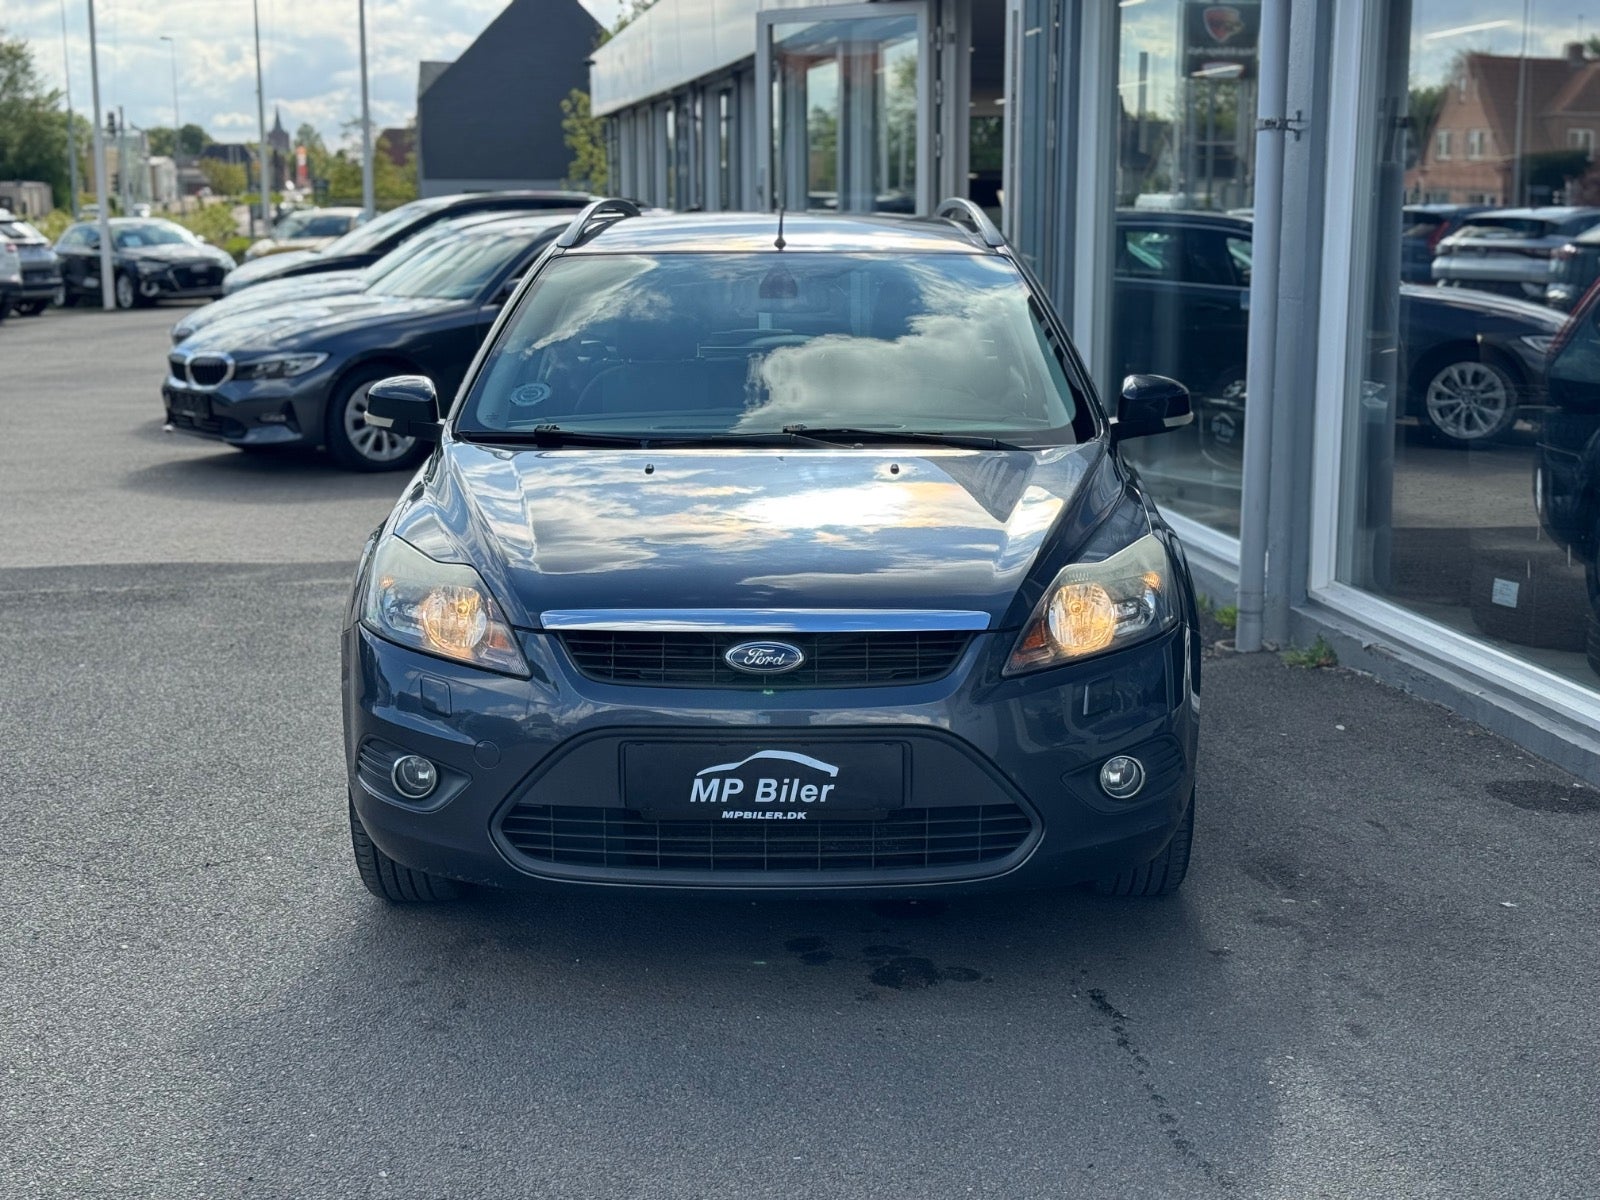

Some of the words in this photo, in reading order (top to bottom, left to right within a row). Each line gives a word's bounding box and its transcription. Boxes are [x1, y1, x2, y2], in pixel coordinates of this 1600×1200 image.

[743, 648, 785, 666] Ford
[689, 778, 744, 803] MP
[754, 778, 835, 803] Biler
[721, 810, 807, 820] MPBILER.DK
